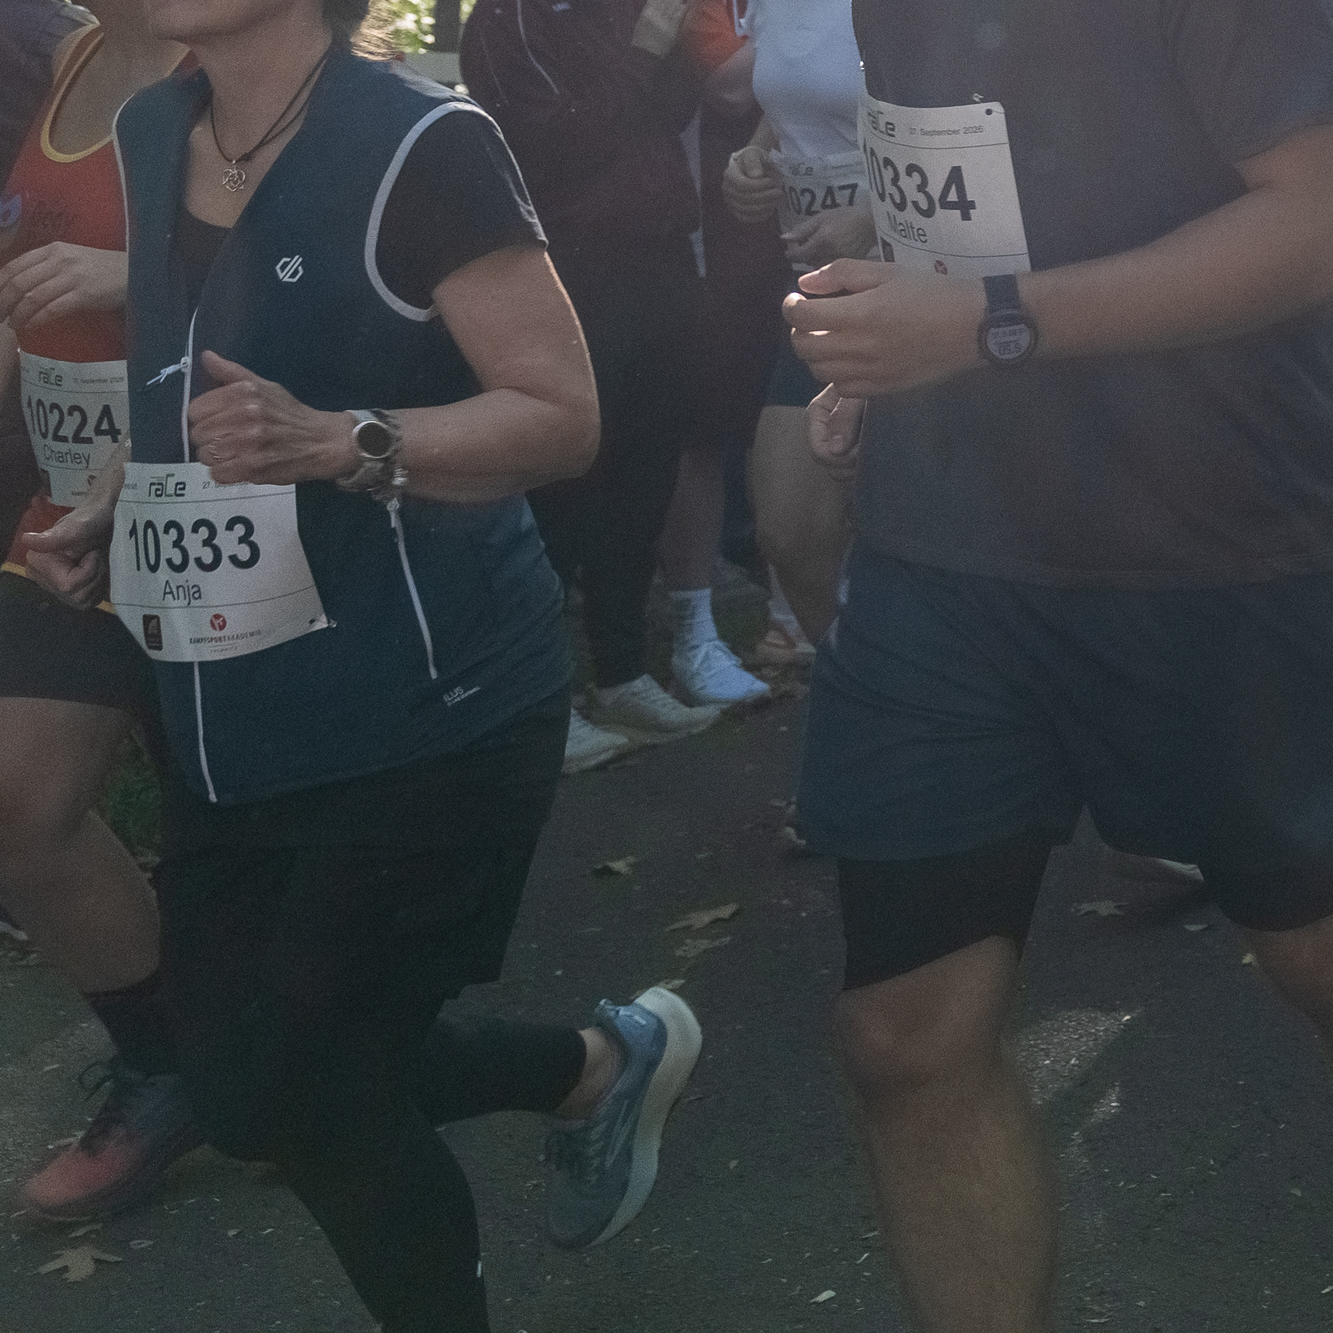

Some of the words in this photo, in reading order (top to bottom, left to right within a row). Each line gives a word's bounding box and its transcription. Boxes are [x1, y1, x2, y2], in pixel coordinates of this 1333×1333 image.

[920, 126, 961, 137] September
[862, 136, 977, 222] 10334
[27, 394, 123, 445] 10224
[43, 443, 92, 469] Charley
[128, 514, 262, 574] 10333
[162, 578, 203, 607] Anja
